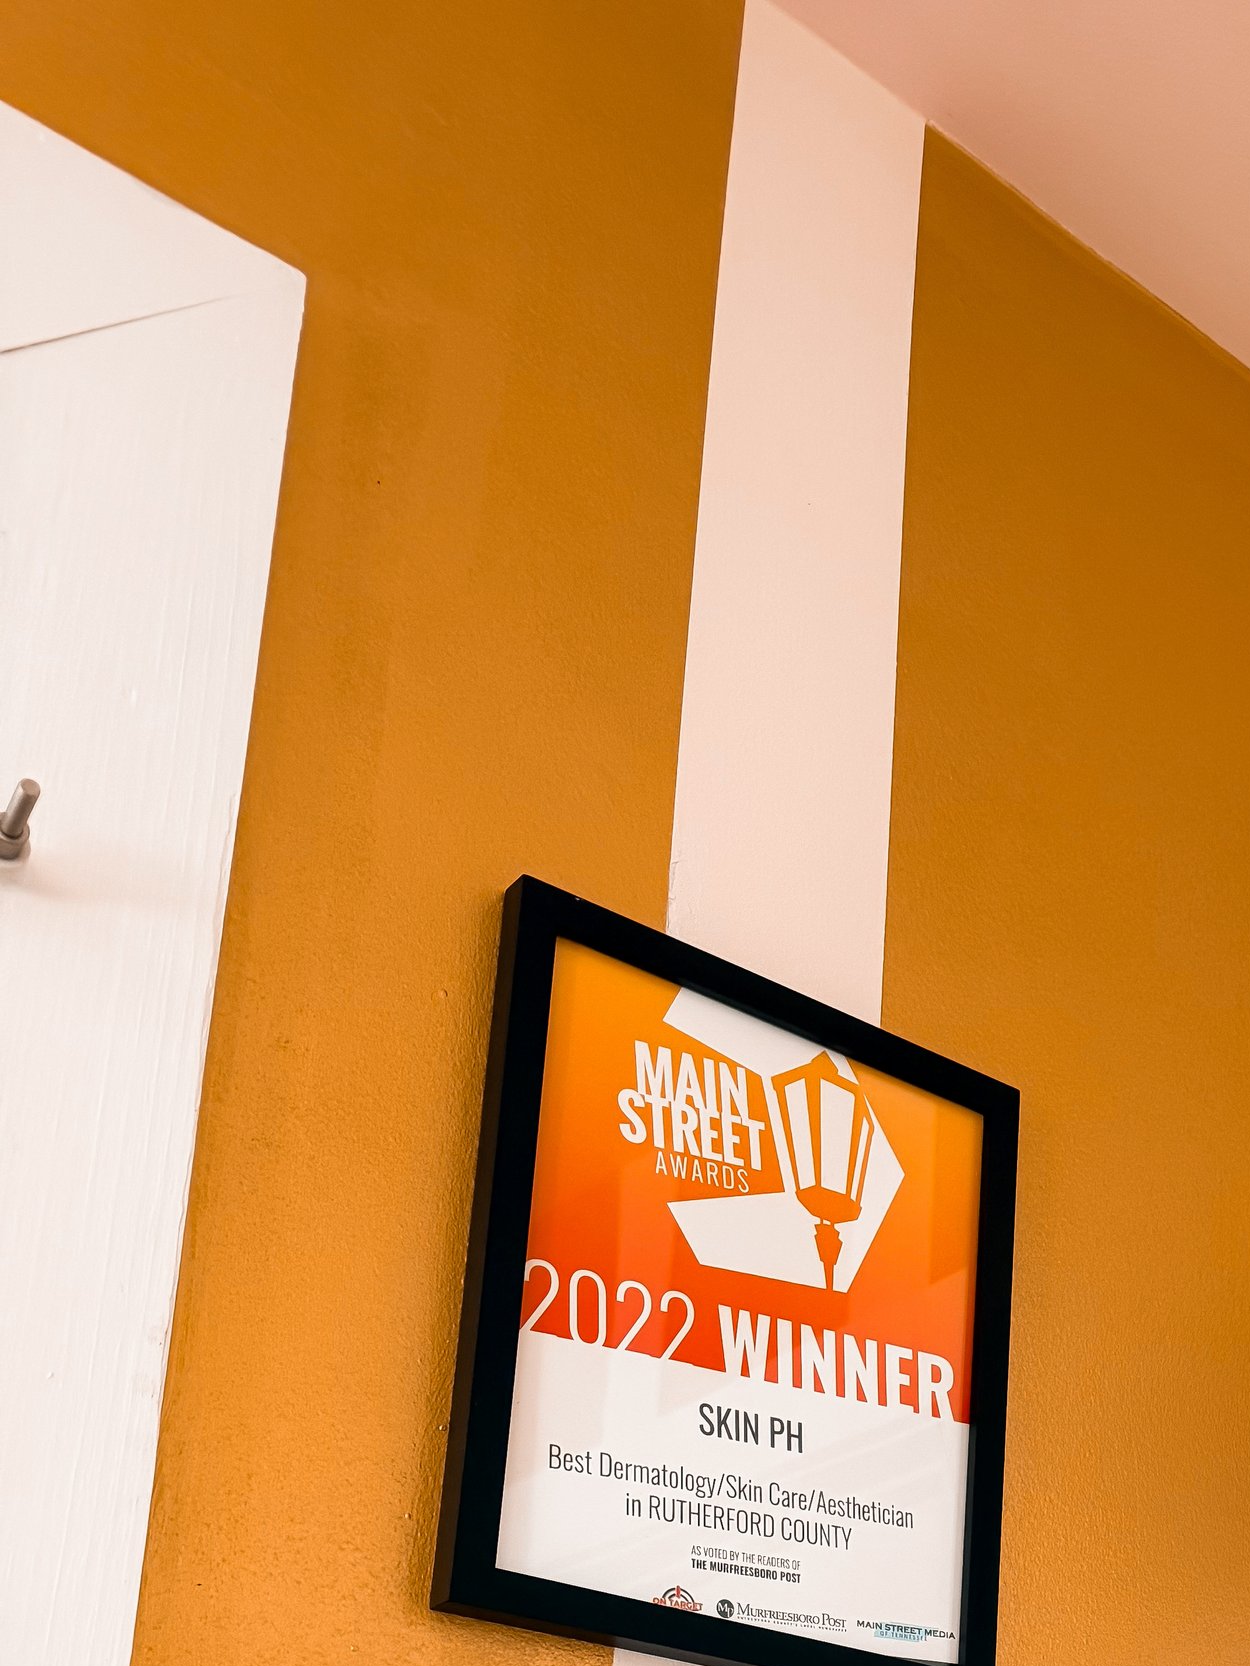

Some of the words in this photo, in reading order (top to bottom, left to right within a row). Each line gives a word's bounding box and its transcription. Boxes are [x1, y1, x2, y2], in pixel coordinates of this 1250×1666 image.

[634, 1039, 748, 1125] MAIN
[617, 1088, 766, 1171] STREET
[655, 1151, 750, 1193] AWARDS
[519, 1258, 696, 1364] 2022
[718, 1303, 956, 1422] WINNER
[699, 1402, 759, 1446] SKIN
[769, 1416, 804, 1454] PH
[548, 1443, 593, 1476] Best
[600, 1451, 763, 1504] Dermatology/Skin
[769, 1481, 914, 1529] Care/Aesthetician
[626, 1493, 642, 1518] in
[649, 1495, 774, 1539] RUTHERFORD
[781, 1517, 852, 1552] COUNTY
[691, 1544, 702, 1556] AS
[703, 1546, 728, 1560] VOTED
[730, 1550, 740, 1562] BY
[742, 1552, 755, 1564] THE
[757, 1553, 790, 1570] READERS
[791, 1559, 801, 1571] OF
[691, 1558, 707, 1570] THE
[709, 1560, 778, 1581] MURFREESBORO
[780, 1571, 801, 1583] POST
[668, 1599, 703, 1612] TARGET
[737, 1602, 820, 1624] MURFREESBORO
[822, 1612, 847, 1628] POST
[856, 1619, 883, 1631] MAIN
[884, 1623, 923, 1635] STREET
[924, 1628, 956, 1640] MEDIA
